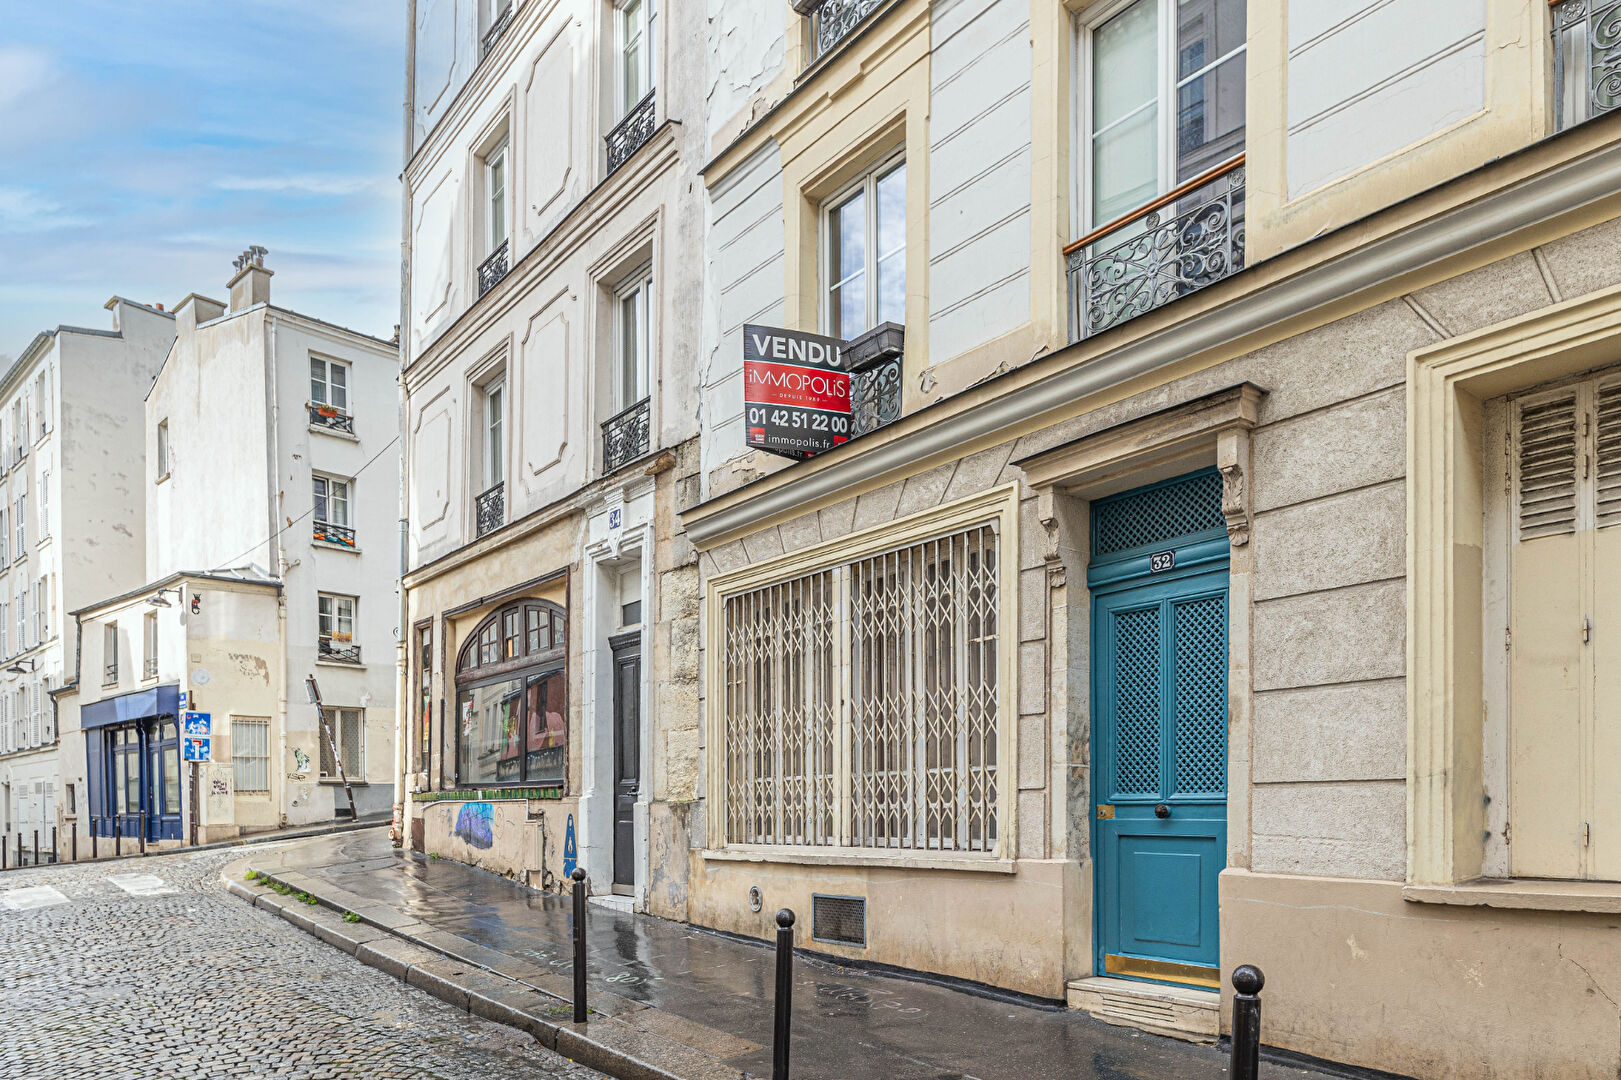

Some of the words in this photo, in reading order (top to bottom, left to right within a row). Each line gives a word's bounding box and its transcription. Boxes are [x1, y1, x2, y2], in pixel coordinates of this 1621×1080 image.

[752, 334, 841, 367] VENDU
[749, 407, 766, 425] 01
[771, 409, 789, 427] 42
[792, 411, 808, 429] 51
[812, 414, 829, 431] 22
[831, 416, 848, 433] 00
[768, 434, 831, 450] immopolis.fr
[609, 510, 621, 528] 34
[1153, 554, 1171, 570] 32
